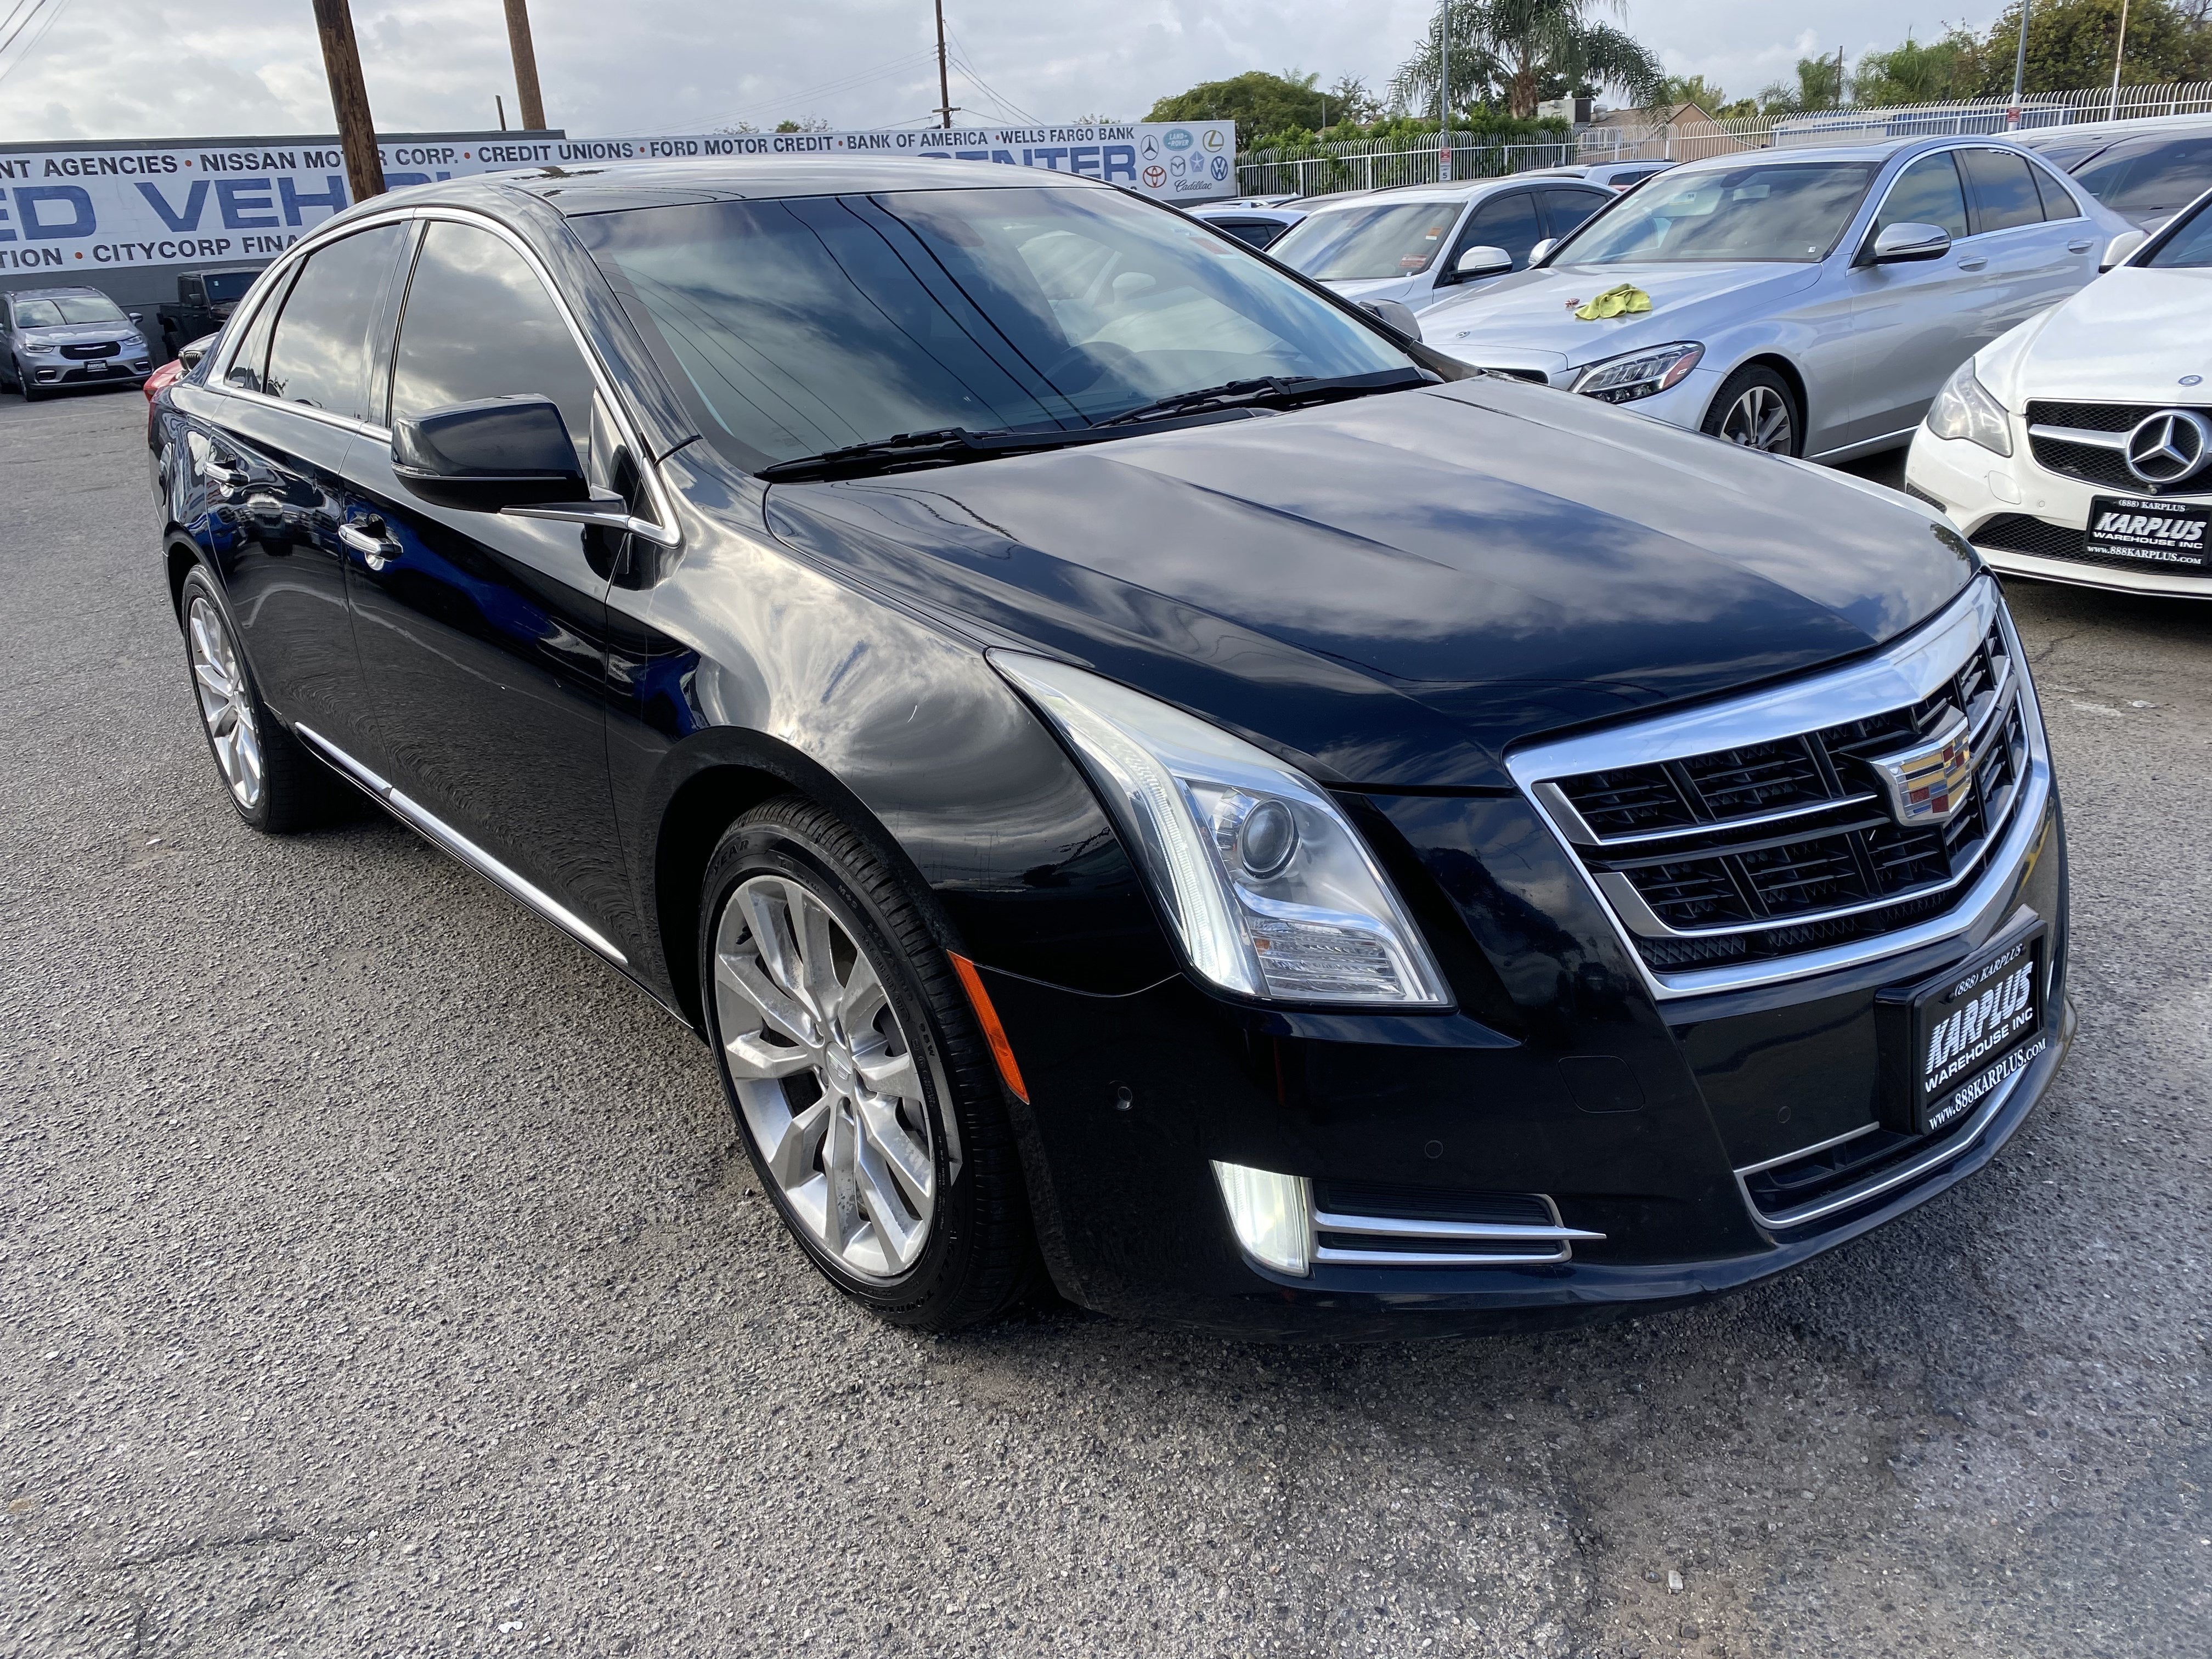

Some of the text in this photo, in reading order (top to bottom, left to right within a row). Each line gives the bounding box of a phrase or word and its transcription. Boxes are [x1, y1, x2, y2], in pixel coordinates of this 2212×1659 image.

[43, 154, 178, 177] AGENCIES
[200, 152, 296, 172] NISSAN
[395, 148, 458, 165] CORP.
[478, 145, 551, 162] CREDIT
[558, 142, 634, 160] UNIONS
[650, 140, 698, 157] FORD
[704, 138, 768, 155] MOTOR
[774, 136, 833, 152] CREDIT
[847, 134, 891, 149] BANK
[896, 133, 916, 148] OF
[920, 132, 989, 147] AMERICA
[1000, 129, 1045, 144] WELLS
[1050, 128, 1094, 142] FARGO
[1099, 127, 1135, 140] BANK
[1175, 179, 1212, 193] Cadillac
[92, 238, 231, 262] CITYCORP
[2119, 499, 2186, 512] (888) KARPLUS
[2094, 512, 2207, 540] KARPLUS
[2092, 532, 2203, 549] WAREHOUSE INC
[1954, 943, 2023, 997] (888) KARPLUS
[1926, 961, 2033, 1075] KARPLUS
[1926, 1007, 2033, 1093] WAREHOUSE INC
